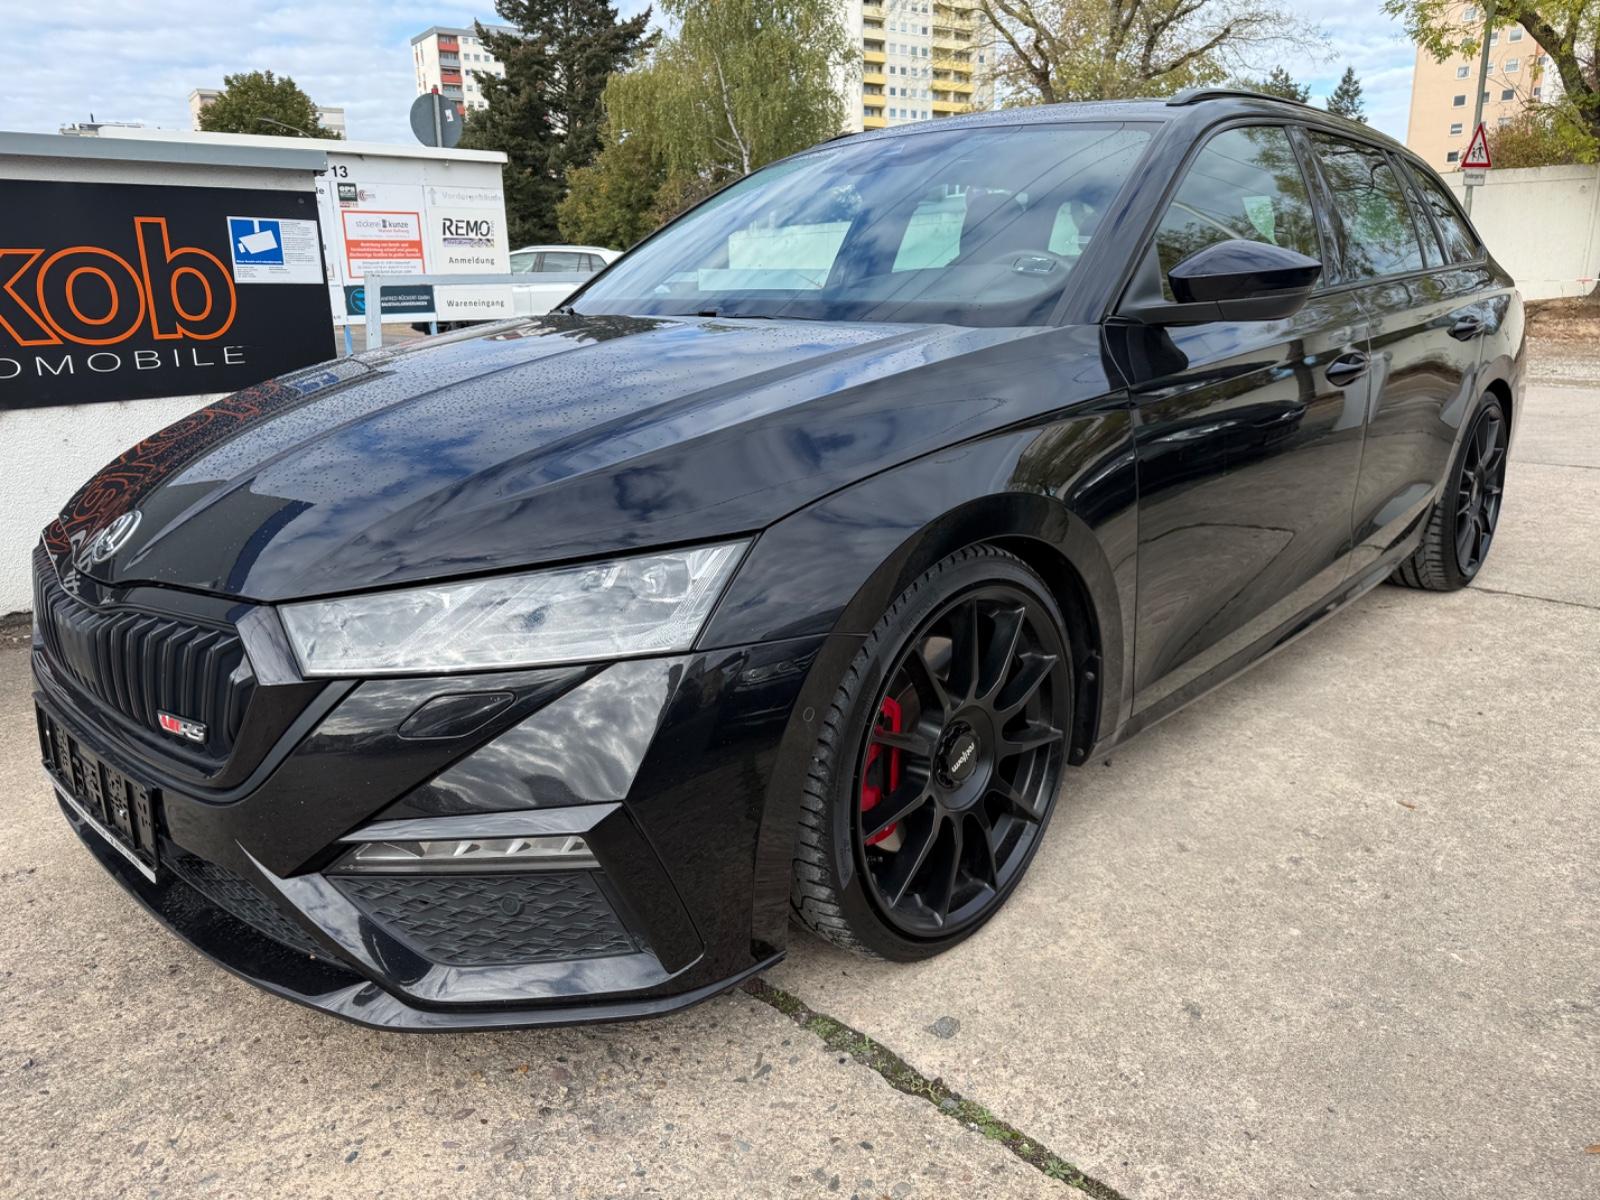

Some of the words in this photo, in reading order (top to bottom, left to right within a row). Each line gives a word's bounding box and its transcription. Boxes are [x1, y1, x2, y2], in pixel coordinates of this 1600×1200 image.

[331, 165, 348, 178] 13
[442, 217, 491, 237] REMO
[448, 256, 496, 266] Anmeldung
[446, 299, 505, 309] Wareneingang
